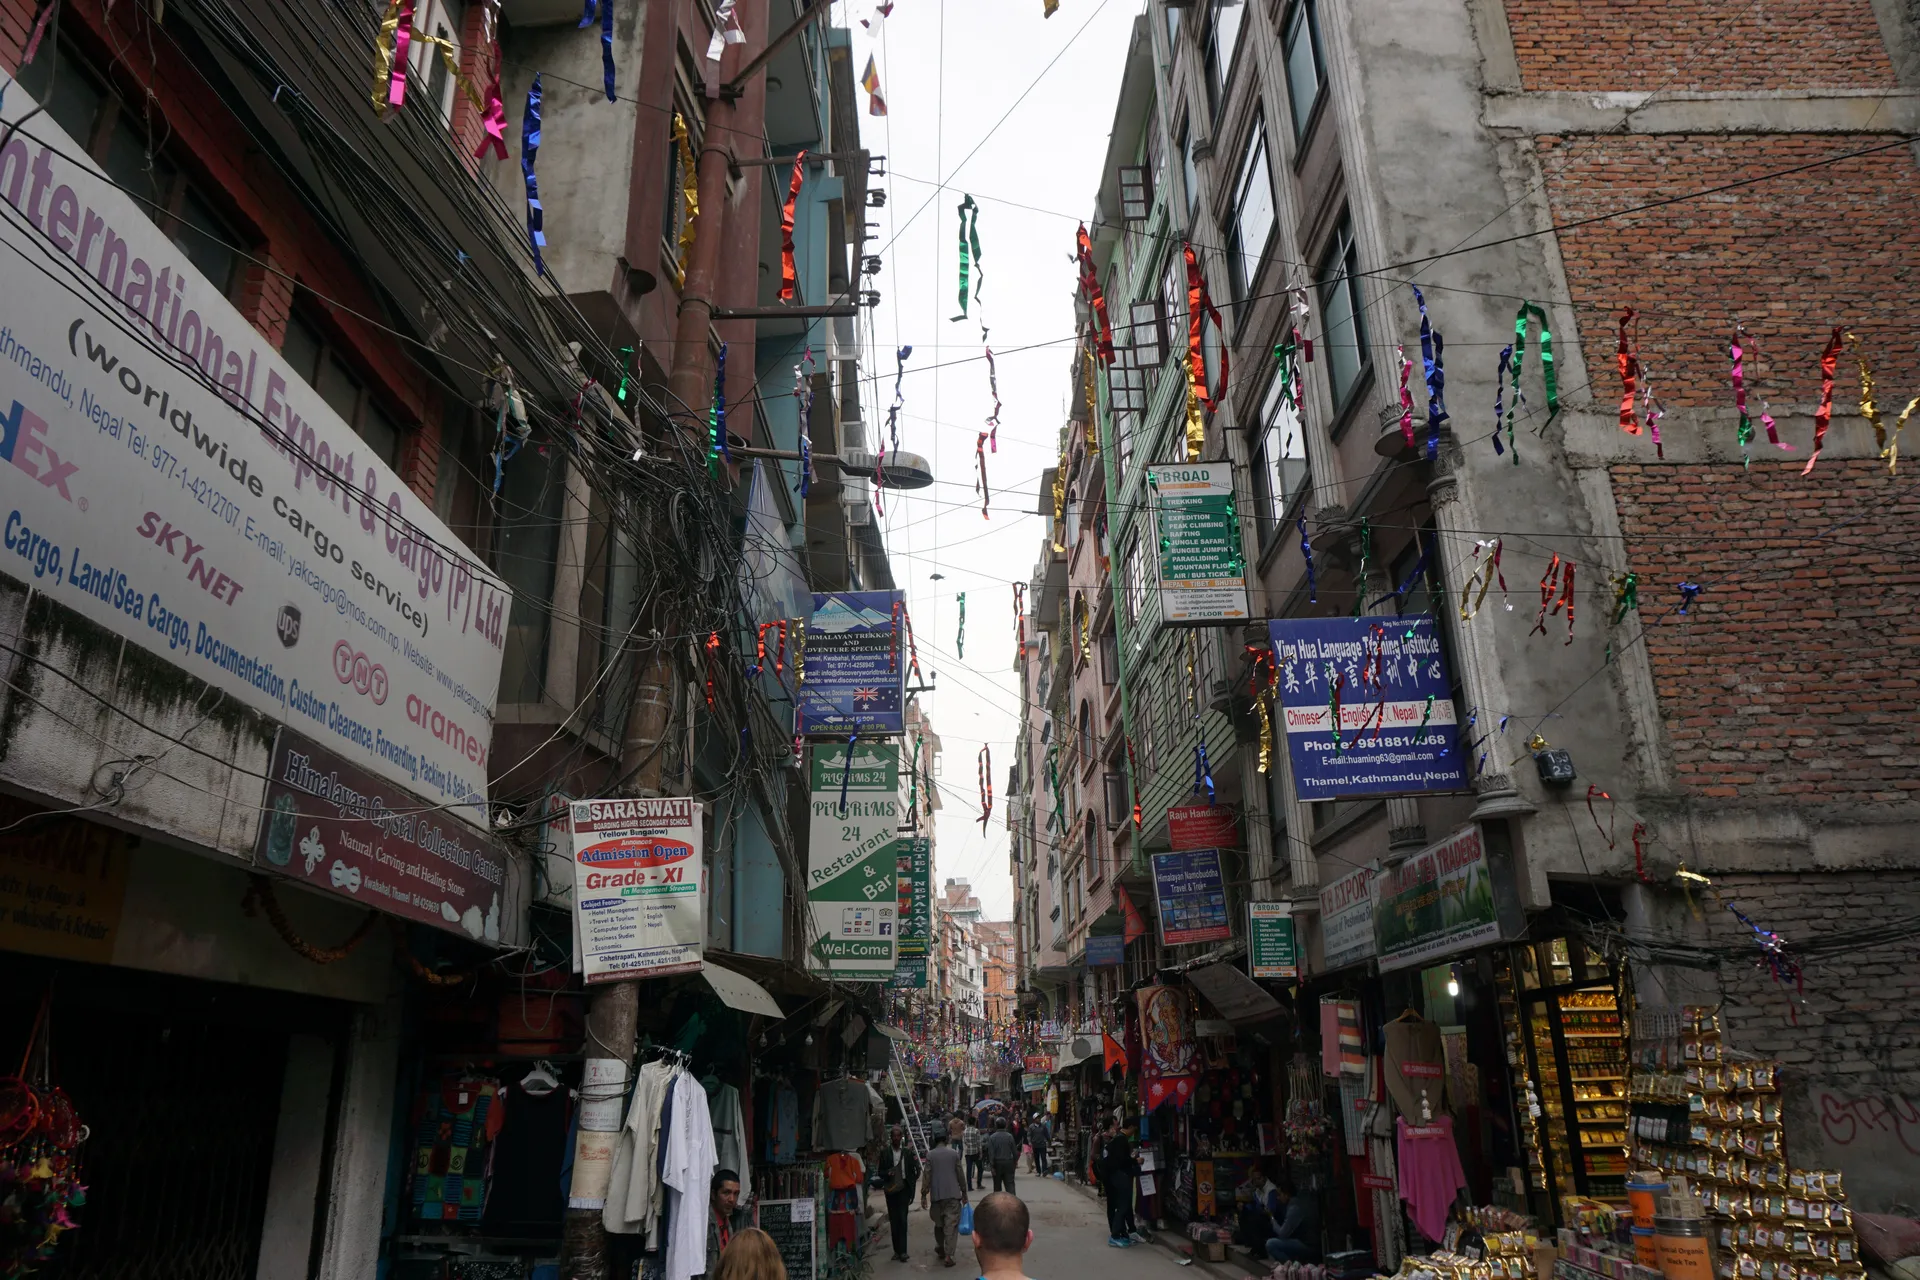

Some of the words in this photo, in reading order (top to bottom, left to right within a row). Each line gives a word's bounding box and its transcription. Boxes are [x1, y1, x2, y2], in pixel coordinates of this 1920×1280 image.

[0, 127, 257, 420] nternational
[260, 367, 354, 514] Export
[360, 467, 376, 535] &
[385, 492, 443, 598] Cargo
[447, 551, 473, 633] (P)
[475, 583, 504, 652] Ltd.
[68, 318, 263, 497] (worldwide
[273, 496, 343, 563] cargo
[351, 560, 428, 637] service)
[80, 387, 123, 440] Nepal
[127, 422, 149, 460] Tel:
[152, 445, 241, 535] 977-1-4212707,
[244, 516, 286, 565] E-mail:
[288, 556, 400, 654] yakcargo@mos.com.np,
[404, 638, 434, 678] Website:
[136, 511, 244, 607] SKYNET
[279, 612, 299, 641] ups
[4, 510, 63, 585] Cargo,
[68, 547, 145, 620] Land/Sea
[146, 594, 190, 656] Cargo,
[195, 622, 286, 708] Documentation,
[290, 678, 326, 725] Custom
[328, 702, 374, 757] Clearance,
[376, 729, 417, 781] Forwarding,
[420, 755, 445, 796] Packing
[1275, 639, 1298, 664] Ying
[1300, 639, 1317, 659] Hua
[1318, 638, 1362, 663] Language
[336, 646, 387, 699] TNT
[1287, 709, 1321, 726] Chinese
[1341, 705, 1371, 727] English
[1392, 703, 1418, 724] Nepali
[406, 693, 487, 771] aramex
[1304, 739, 1354, 752] Phone:
[1322, 752, 1434, 766] E-mail:huaming63@gmail.com
[873, 771, 886, 784] 24
[1303, 770, 1460, 787] Thamel,Kathmandu,Nepal
[284, 749, 368, 818] Himalayan
[370, 796, 417, 842] Crystal
[418, 819, 470, 874] Collection
[471, 849, 502, 885] Center
[591, 800, 688, 820] SARASWATI
[1169, 810, 1188, 821] Raju
[593, 821, 620, 830] BOARDING
[621, 820, 638, 828] HIGHER
[639, 819, 668, 827] SECONDARY
[670, 818, 689, 826] SCHOOL
[599, 831, 627, 839] (Yellow
[842, 826, 861, 842] 24
[582, 846, 649, 862] Admission
[654, 845, 687, 860] Open
[811, 827, 892, 882] Restaurant
[913, 840, 926, 873] HOTEL
[1418, 855, 1437, 884] TEA
[1436, 831, 1482, 876] TRADERS
[339, 830, 373, 860] Natural,
[376, 847, 405, 875] Carving
[406, 862, 420, 878] and
[421, 868, 446, 893] Healing
[447, 880, 465, 896] Stone
[863, 865, 877, 878] &
[586, 870, 645, 889] Grade
[662, 867, 683, 884] XI
[1157, 872, 1184, 883] Himalayan
[392, 887, 410, 903] Thamel
[669, 884, 695, 892] Streams
[862, 873, 892, 900] Bar
[1170, 884, 1187, 893] Travel
[1188, 883, 1192, 891] &
[583, 900, 601, 909] Subject
[607, 906, 639, 915] Management
[913, 881, 927, 934] NEPALAYA
[1320, 888, 1333, 916] KB
[593, 926, 618, 934] Computer
[595, 943, 622, 951] Economics
[821, 943, 889, 955] Wel-Come
[599, 954, 637, 962] Chhetrapati,
[1679, 1247, 1704, 1255] Organic
